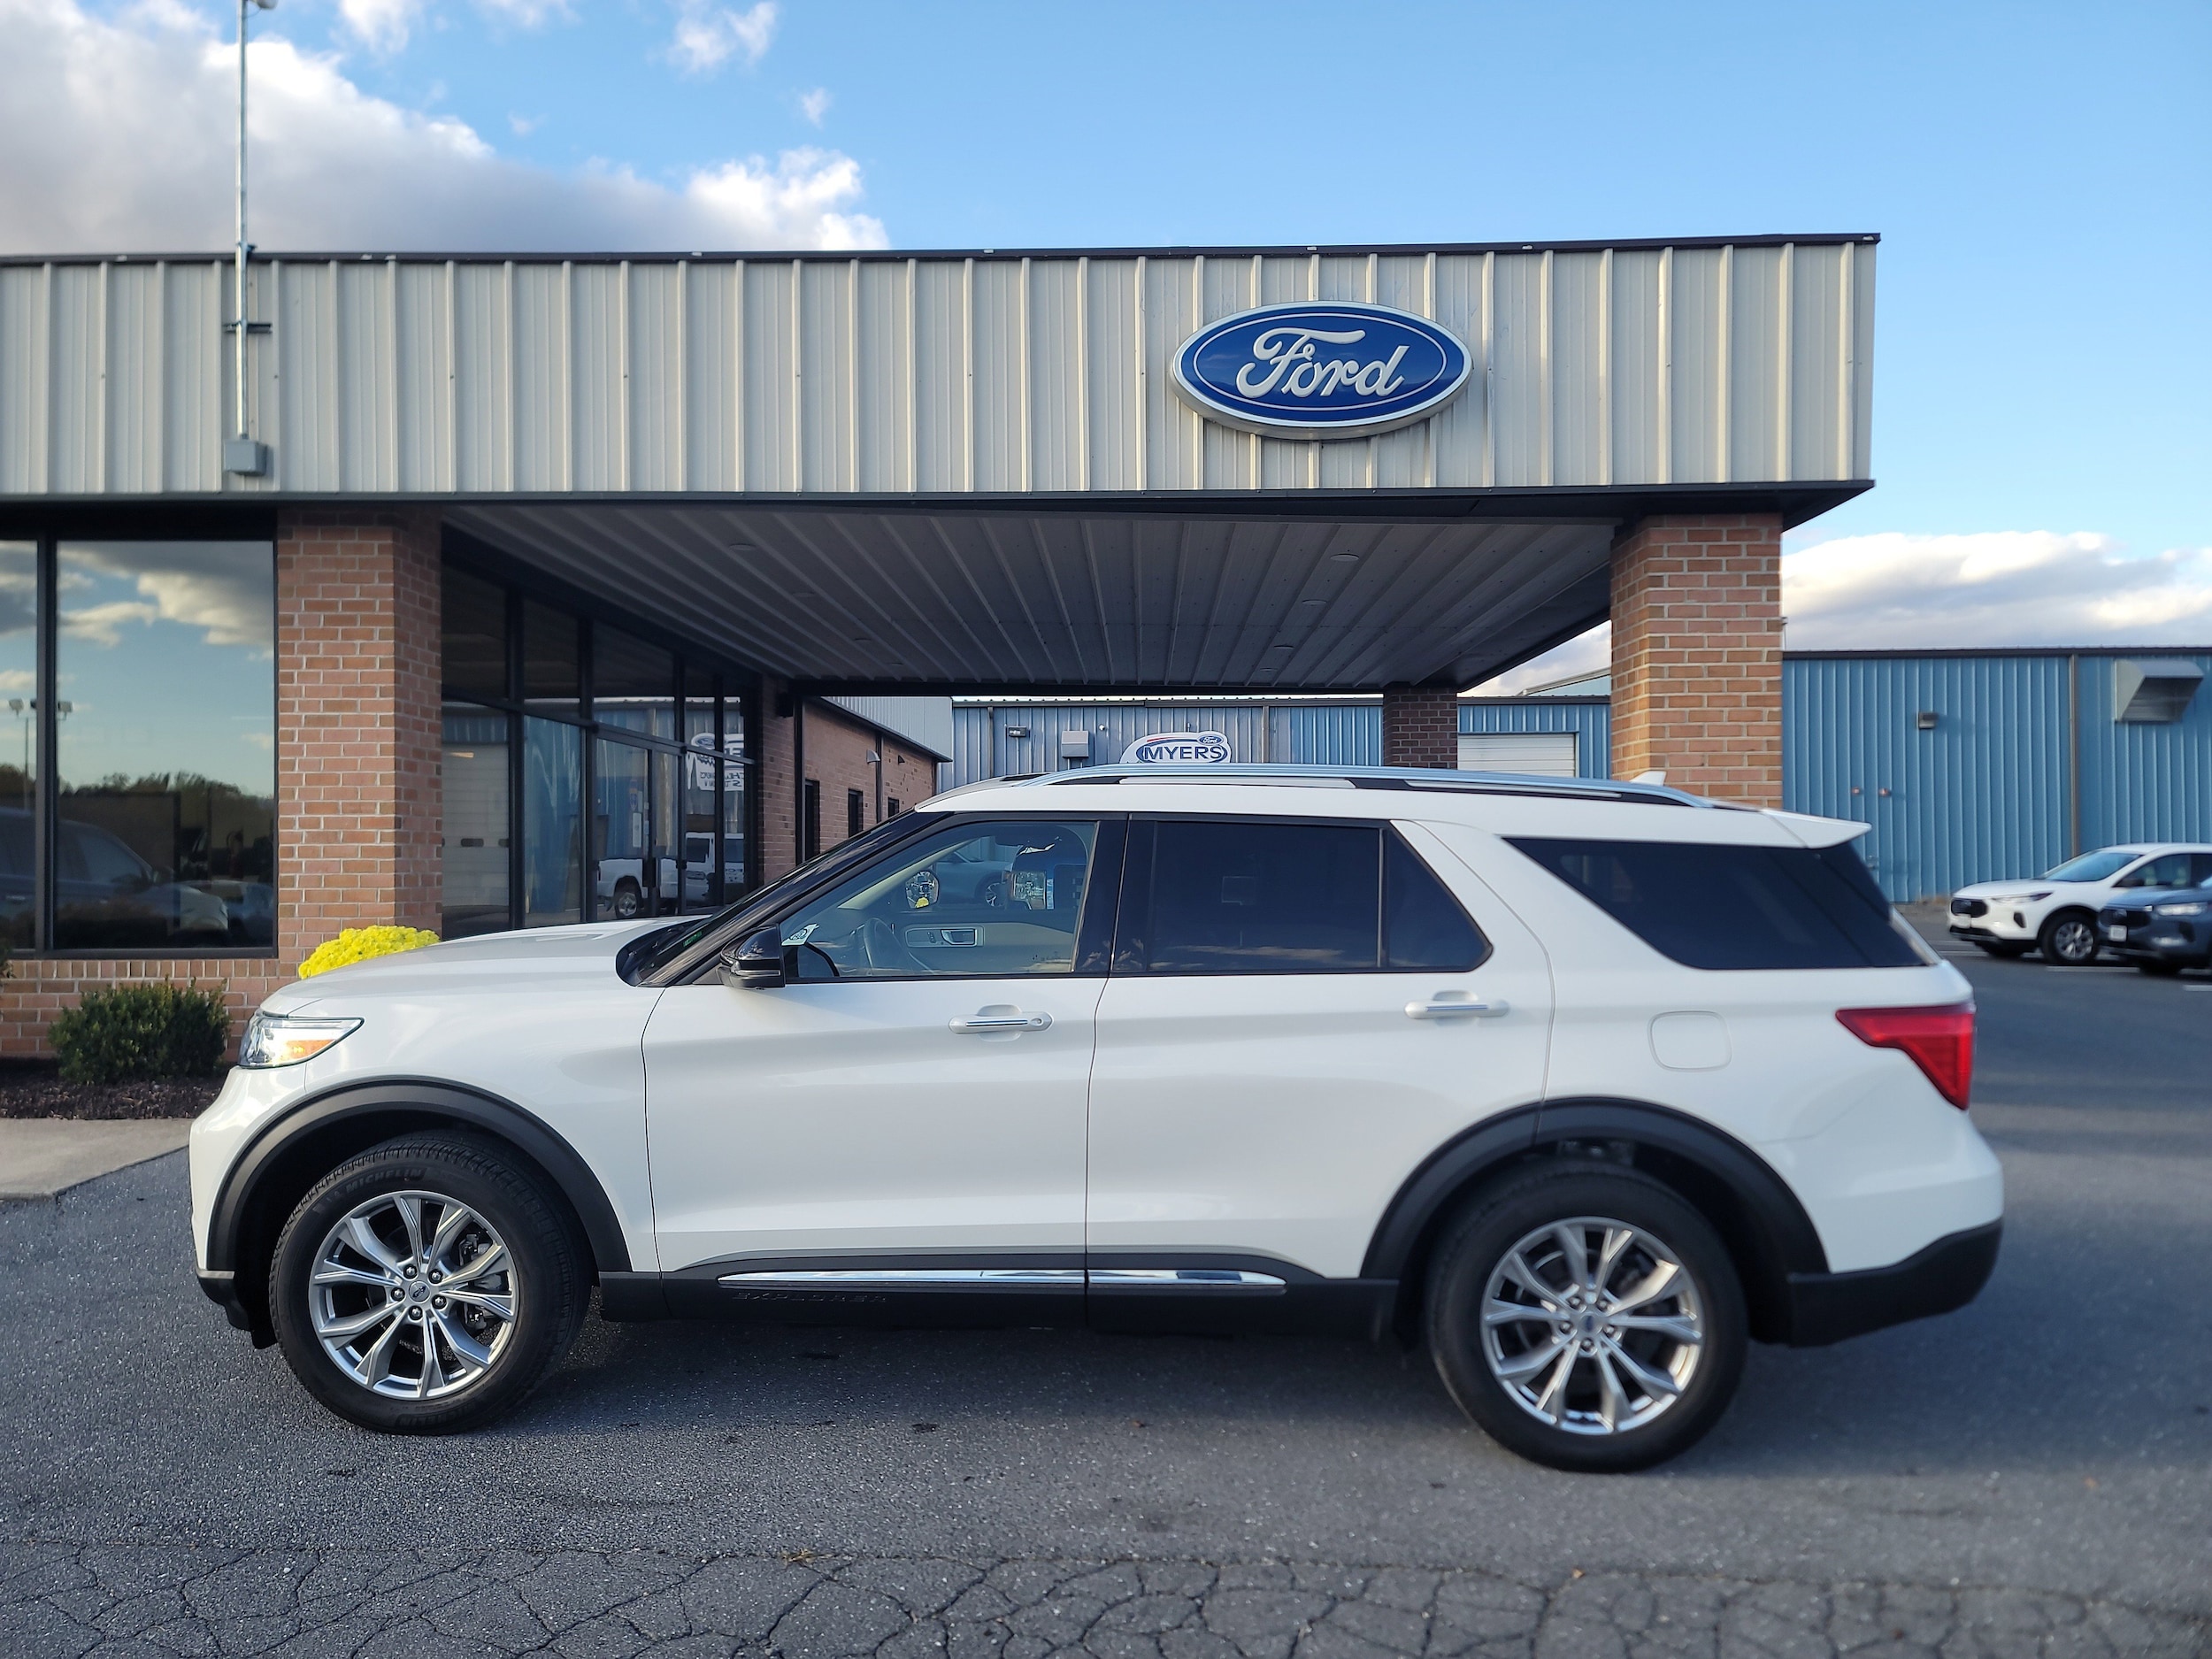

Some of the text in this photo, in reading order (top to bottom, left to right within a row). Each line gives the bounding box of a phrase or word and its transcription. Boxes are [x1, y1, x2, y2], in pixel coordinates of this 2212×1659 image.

[1236, 327, 1410, 398] Ford
[1144, 746, 1222, 760] MYERS
[345, 1167, 424, 1193] MICHELIN
